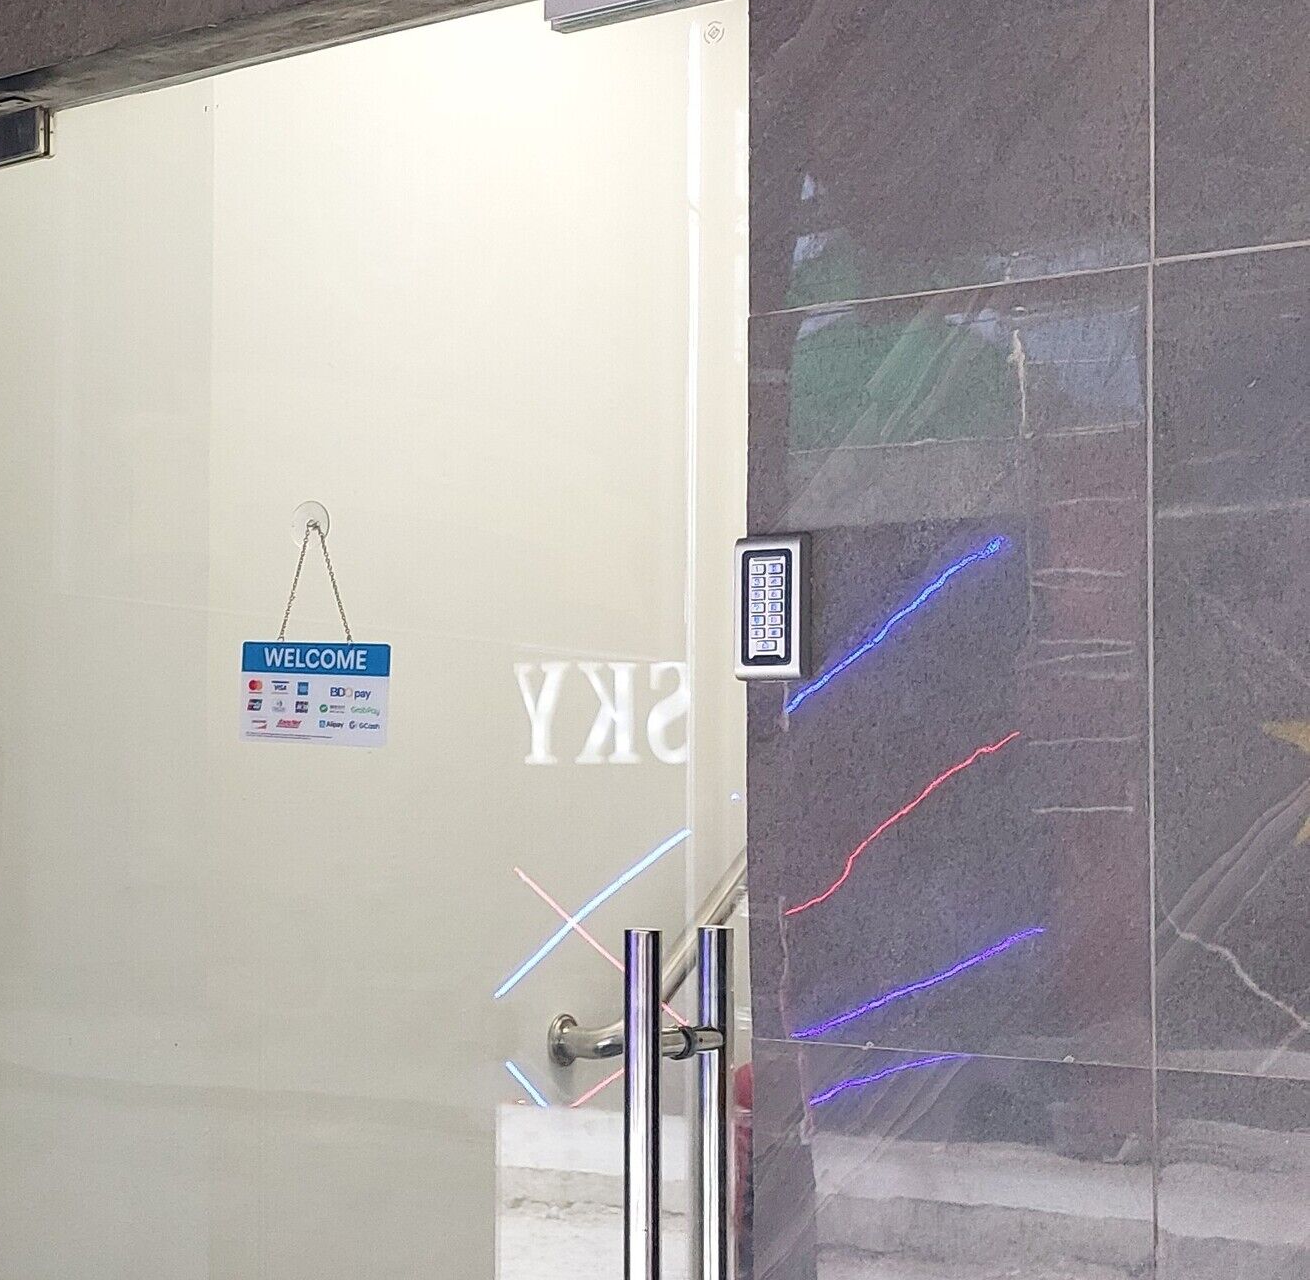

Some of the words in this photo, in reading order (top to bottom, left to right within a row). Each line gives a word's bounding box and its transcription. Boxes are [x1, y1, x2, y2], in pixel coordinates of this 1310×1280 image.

[264, 647, 368, 670] WELCOME
[330, 686, 353, 698] BDO
[354, 689, 371, 701] pay
